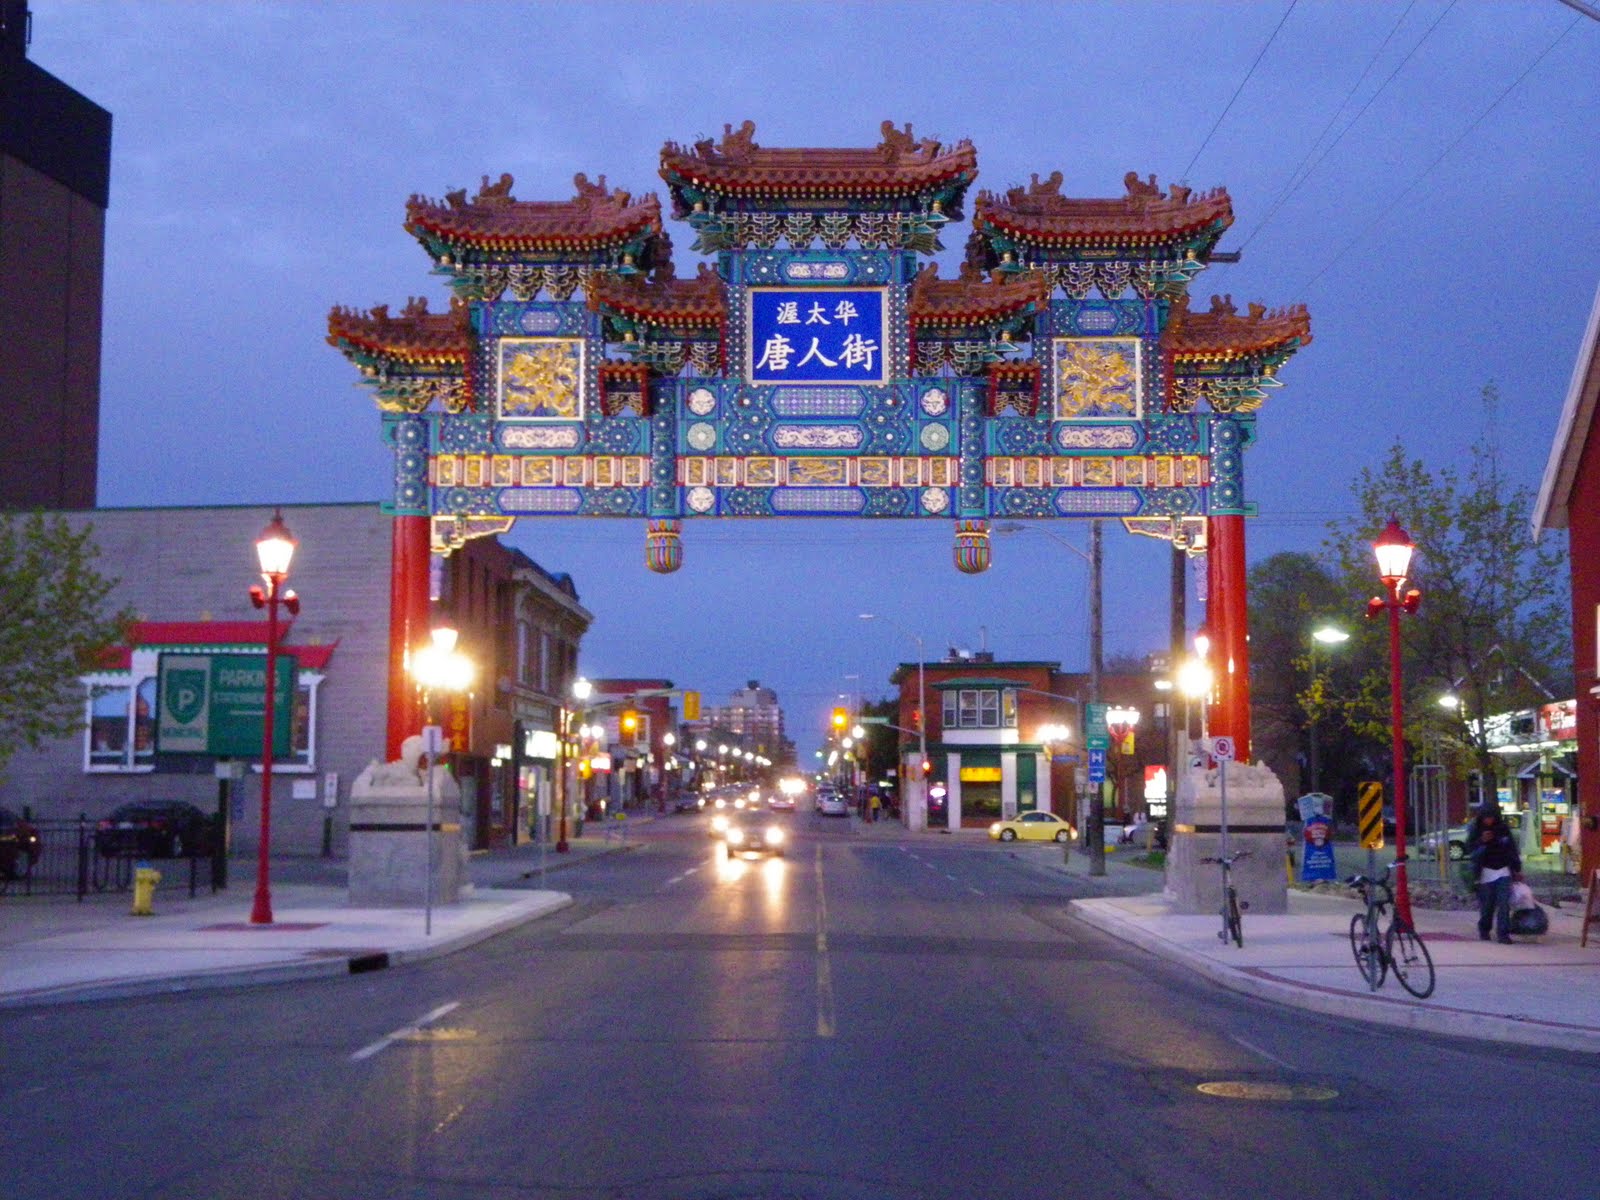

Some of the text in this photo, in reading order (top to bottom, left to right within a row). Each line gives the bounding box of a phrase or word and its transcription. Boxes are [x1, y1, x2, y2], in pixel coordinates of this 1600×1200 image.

[776, 300, 859, 326] 渥太华
[756, 333, 879, 371] 唐人街
[178, 688, 194, 711] P
